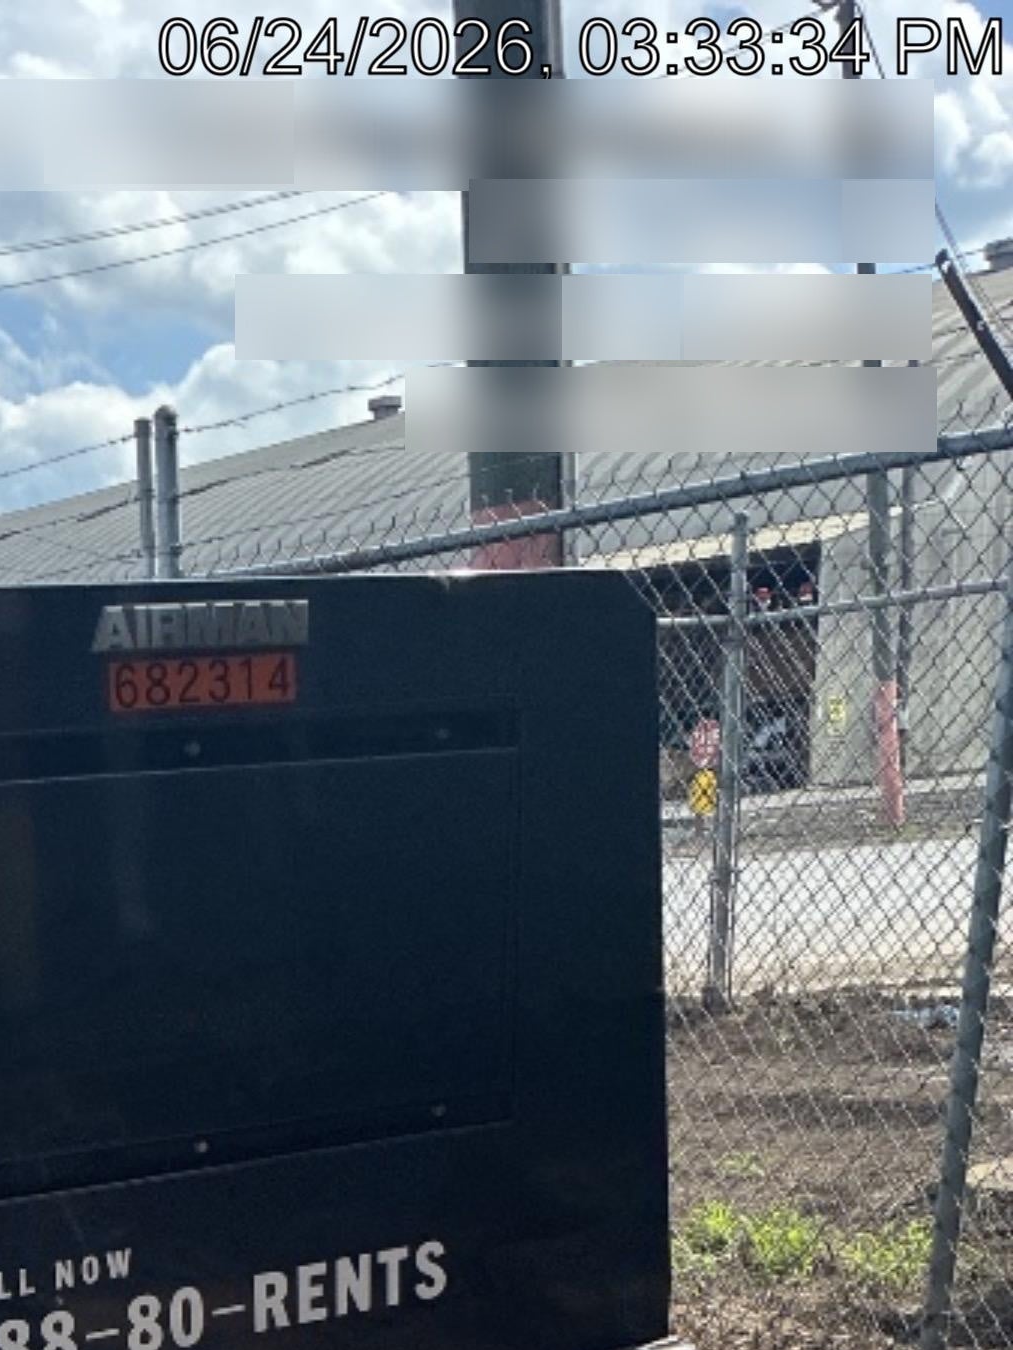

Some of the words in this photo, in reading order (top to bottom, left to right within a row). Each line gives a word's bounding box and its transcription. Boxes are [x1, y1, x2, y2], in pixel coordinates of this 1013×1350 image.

[92, 599, 310, 654] AIRMAN
[114, 657, 290, 709] 682314
[54, 1247, 133, 1291] NOW
